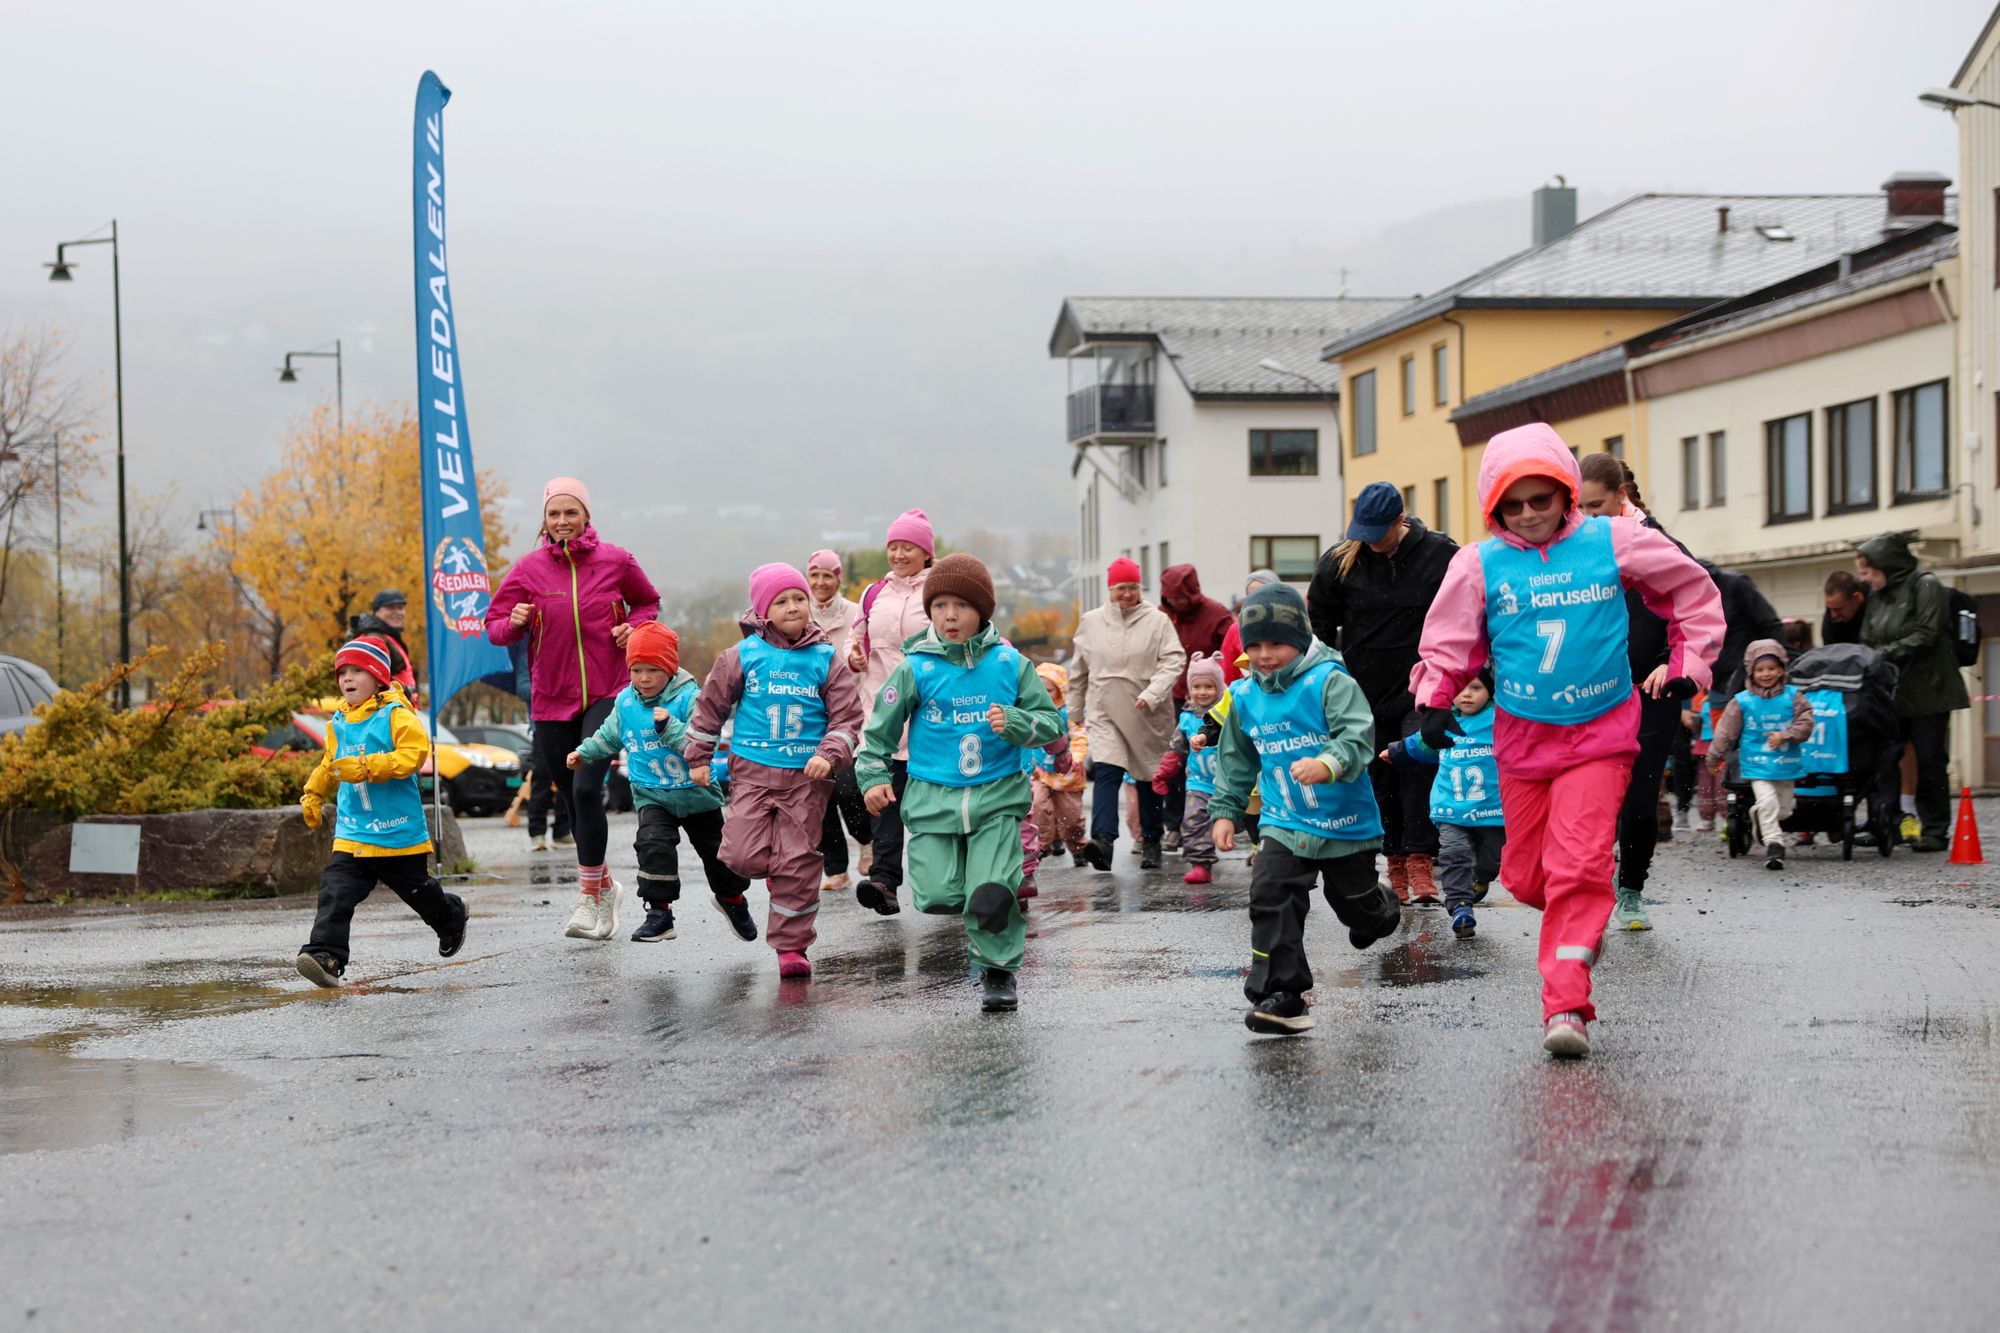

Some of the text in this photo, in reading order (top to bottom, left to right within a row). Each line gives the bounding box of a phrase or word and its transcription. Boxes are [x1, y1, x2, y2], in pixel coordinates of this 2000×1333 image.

[427, 112, 469, 519] VELLEDALEN IL
[1528, 571, 1573, 588] telenor
[1530, 584, 1618, 608] karusellen
[458, 619, 480, 631] 1906
[1536, 618, 1566, 674] 7
[769, 669, 799, 681] telenor
[1574, 676, 1619, 699] telenor
[951, 693, 988, 707] telenor
[765, 703, 804, 740] 15
[793, 743, 818, 754] telen
[959, 733, 983, 778] 8
[1450, 744, 1493, 760] karusell
[647, 753, 688, 786] 19
[1272, 765, 1320, 812] 11
[1448, 765, 1487, 802] 12
[378, 815, 409, 830] telenor
[1475, 807, 1504, 820] teleno
